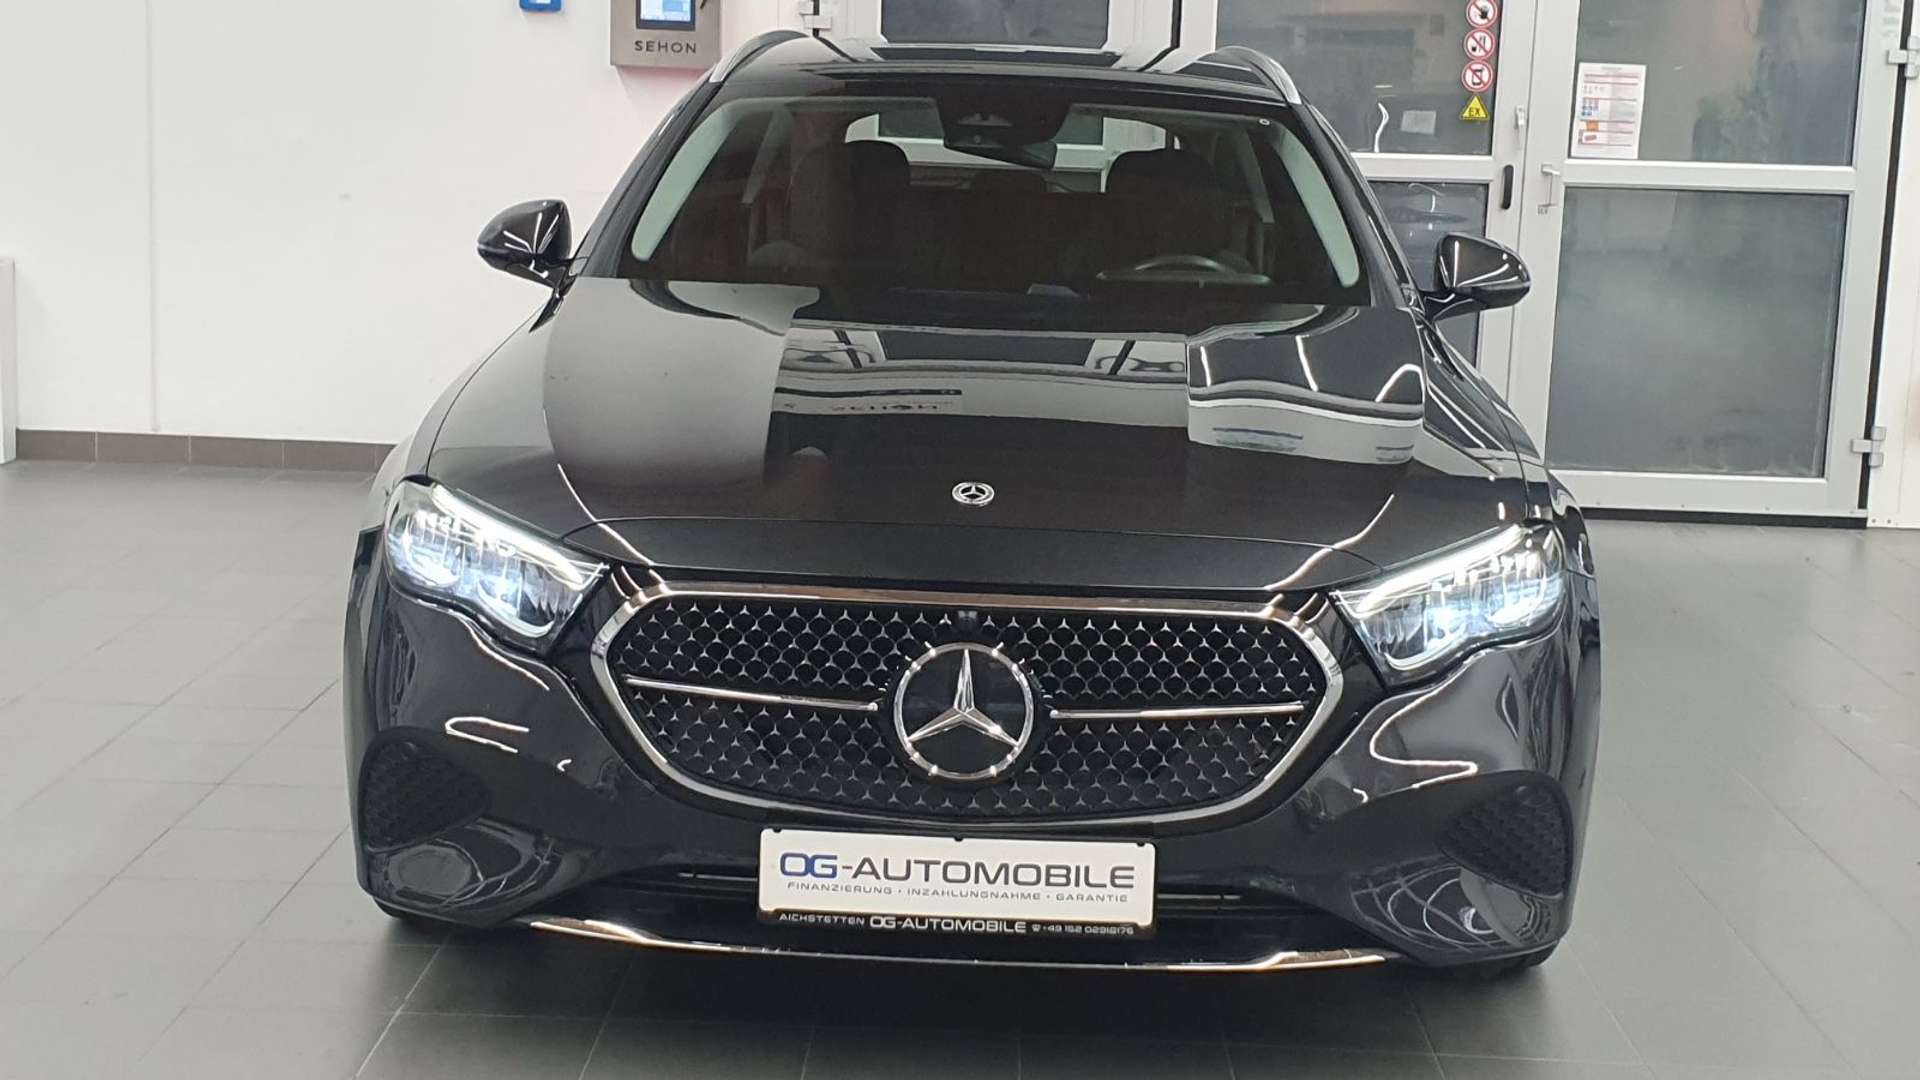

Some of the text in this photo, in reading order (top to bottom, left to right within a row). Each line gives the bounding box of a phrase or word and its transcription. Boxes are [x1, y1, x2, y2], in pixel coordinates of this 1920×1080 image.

[634, 40, 697, 54] SEHON
[1468, 107, 1481, 117] EX
[780, 852, 1135, 889] OG-AUTOMOBILE
[787, 881, 1128, 903] FINANZIERUNG INZAHLUNGNAHME GARANTIE
[779, 913, 865, 925] AICHSTETTEN
[870, 915, 1026, 933] OG-AUTOMOBILE
